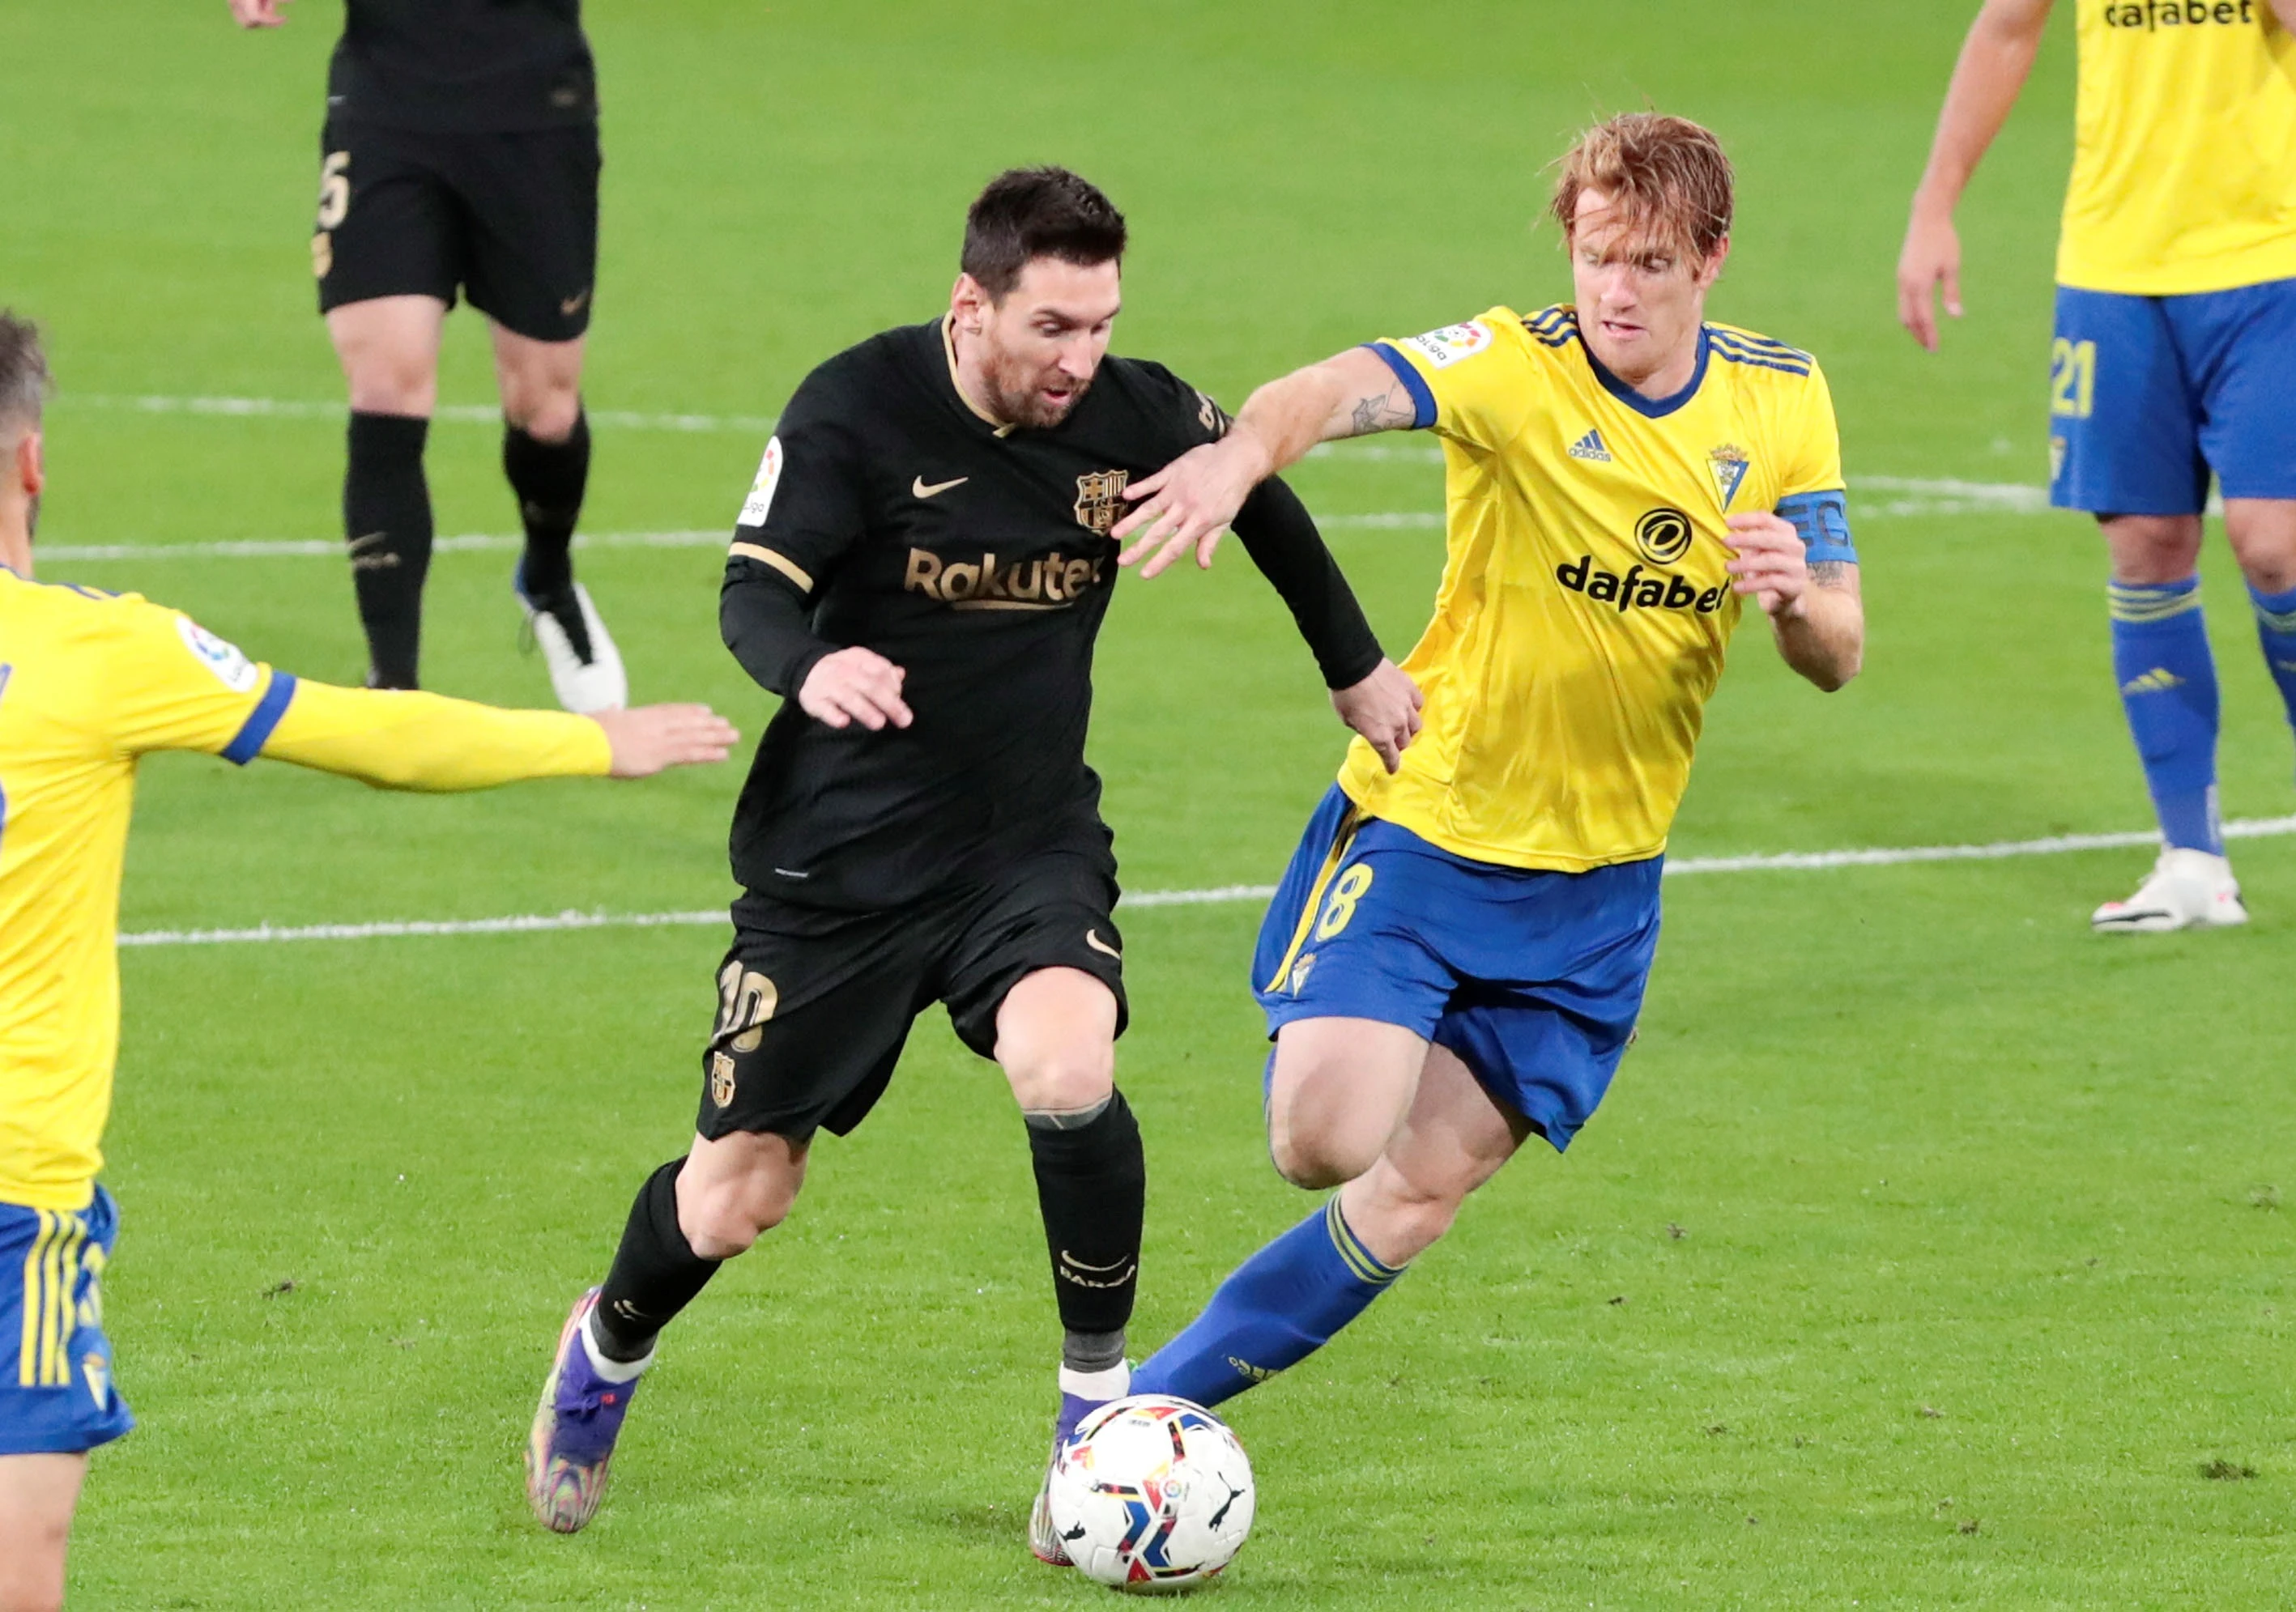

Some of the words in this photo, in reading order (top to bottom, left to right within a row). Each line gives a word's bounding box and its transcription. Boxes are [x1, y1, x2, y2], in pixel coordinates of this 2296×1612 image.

[317, 151, 351, 230] 5
[2052, 337, 2096, 418] 21
[1568, 447, 1611, 462] adidas
[1315, 862, 1374, 942] 8
[712, 959, 778, 1053] 10
